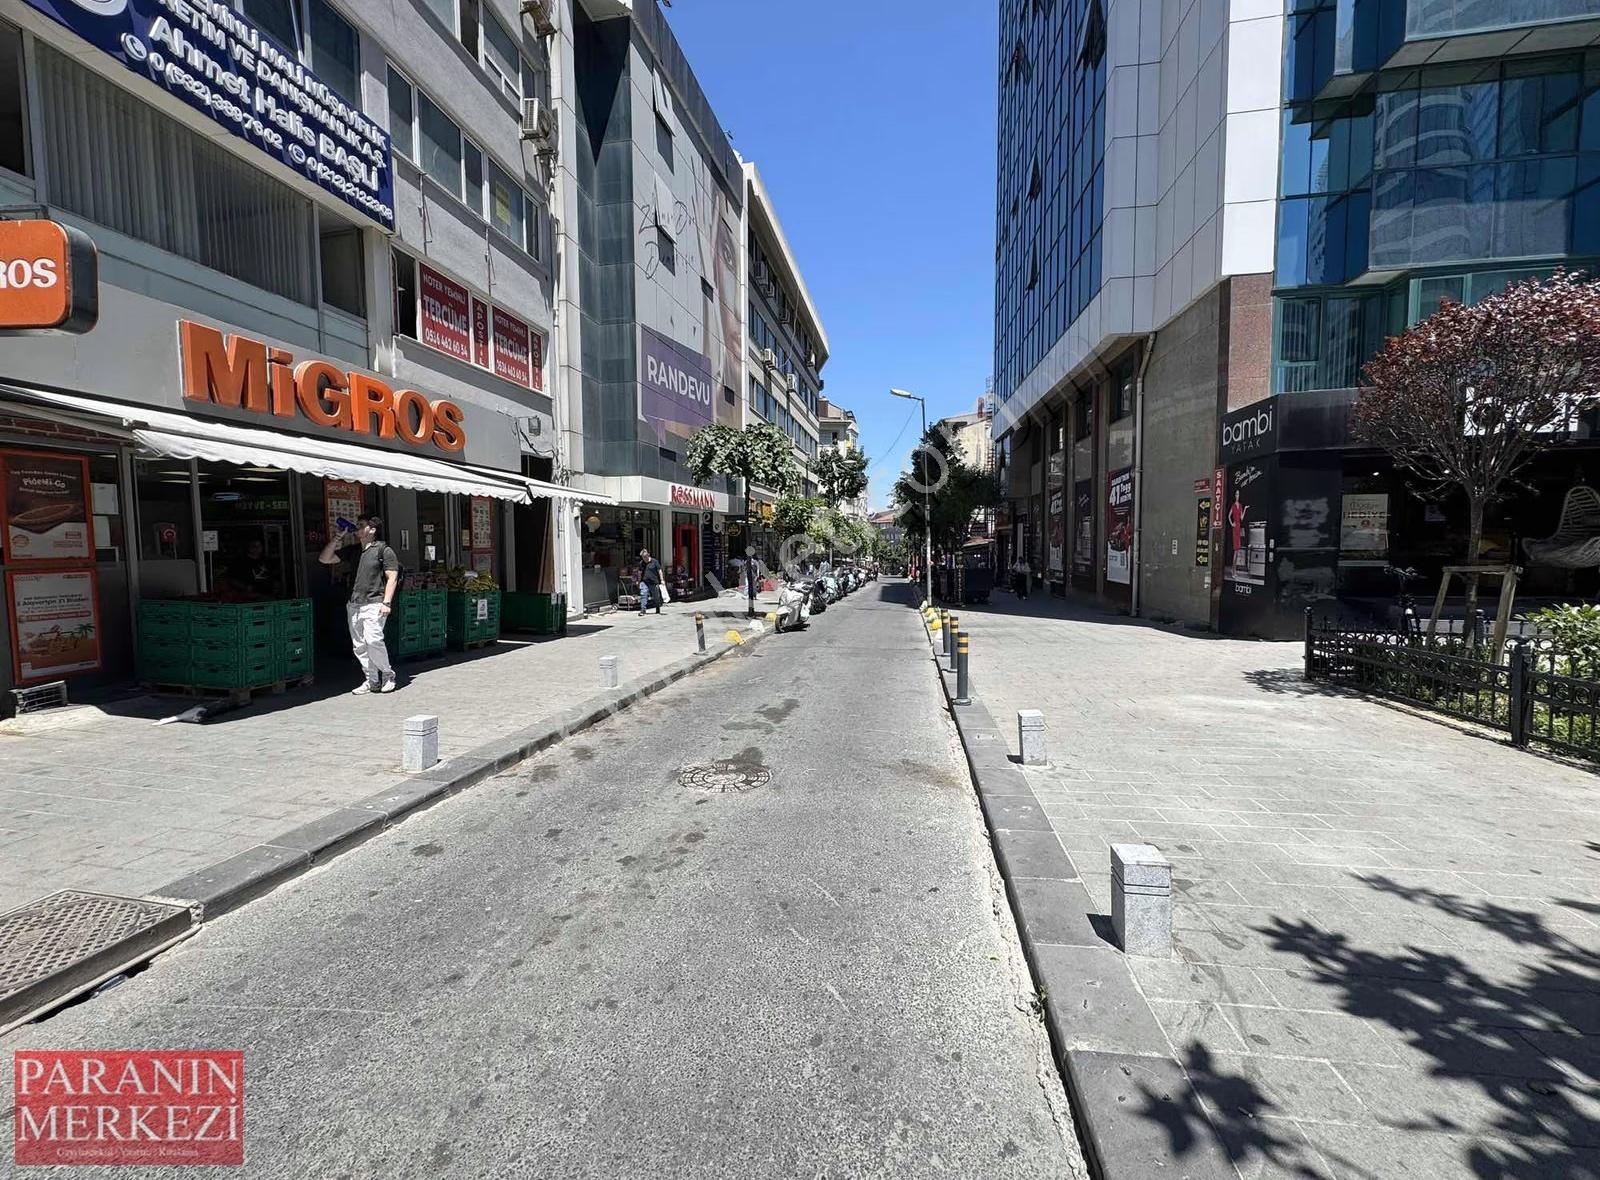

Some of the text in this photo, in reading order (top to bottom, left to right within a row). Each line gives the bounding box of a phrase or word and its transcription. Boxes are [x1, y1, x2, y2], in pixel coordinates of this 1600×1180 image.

[149, 16, 251, 105] Ahmet
[255, 87, 316, 148] Halis
[229, 38, 256, 72] VE
[257, 59, 362, 151] DANIŞMANLIK
[261, 40, 304, 86] MALİ
[304, 75, 387, 151] MÜŞAVİRLİK
[0, 258, 57, 289] OS
[423, 294, 468, 337] TERCÜME
[647, 355, 710, 406] RANDEVU
[1222, 404, 1273, 447] bambi
[671, 485, 715, 510] ROSSMANN
